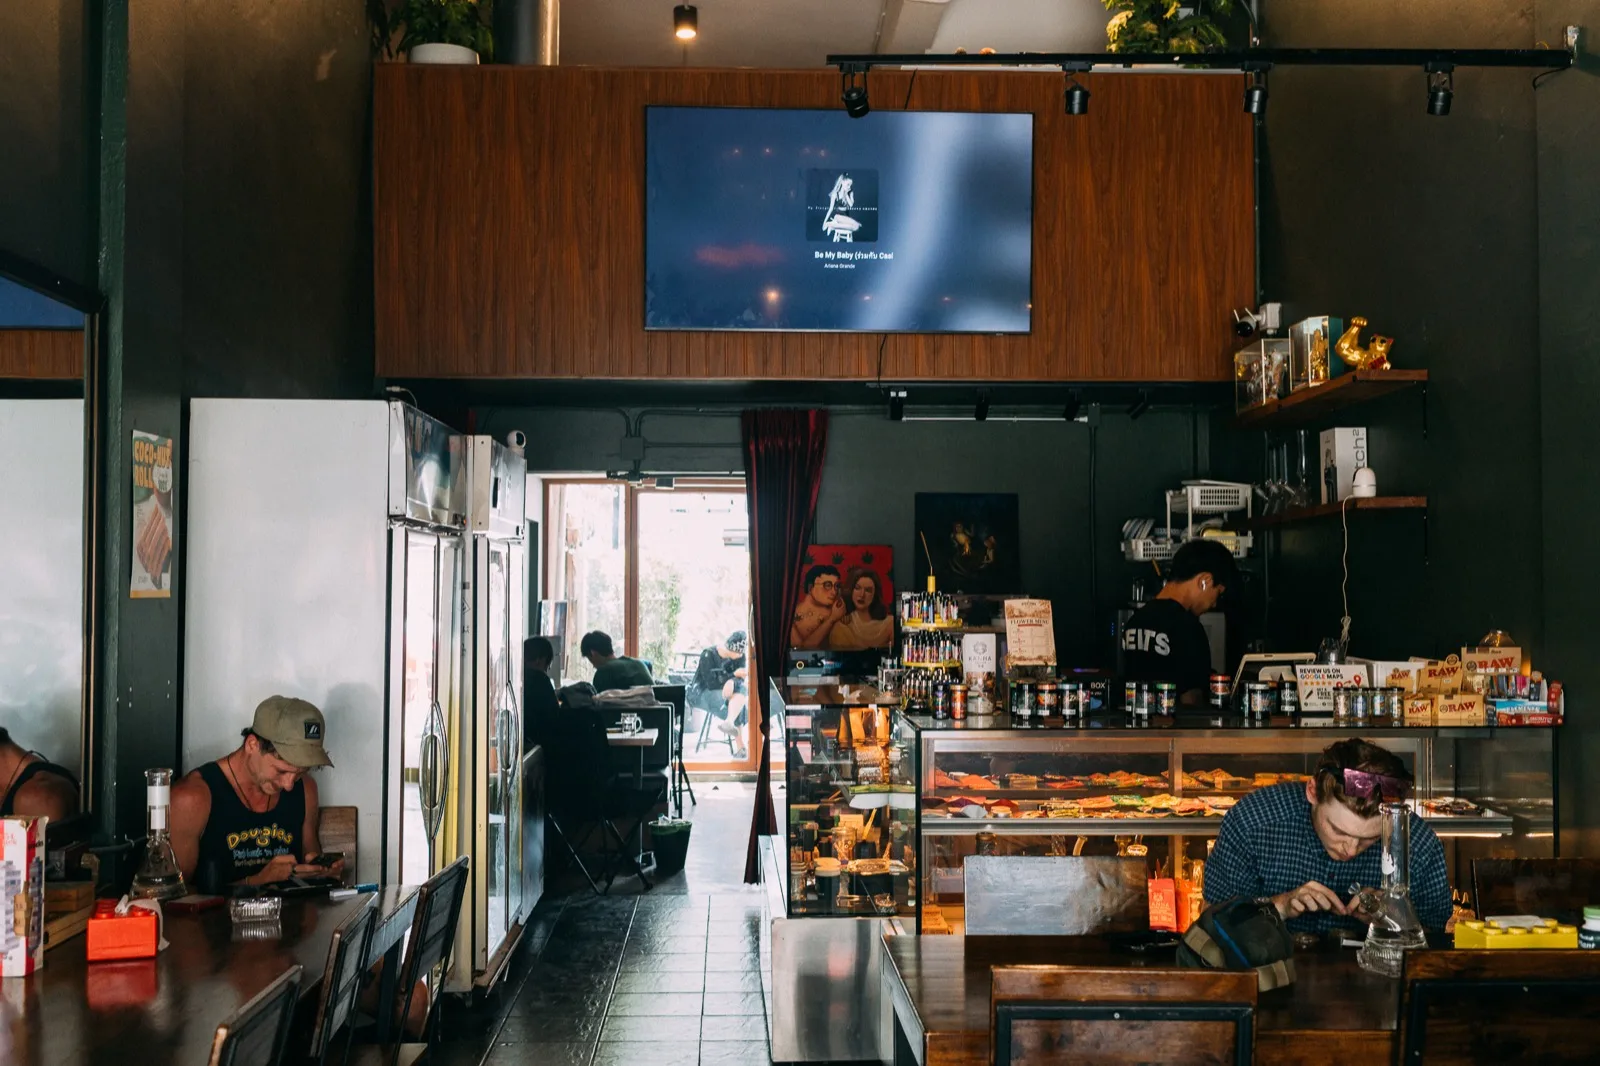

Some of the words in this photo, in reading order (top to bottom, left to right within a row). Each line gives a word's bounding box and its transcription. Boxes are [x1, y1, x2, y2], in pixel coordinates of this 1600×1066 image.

[814, 251, 824, 259] Be
[825, 251, 836, 260] My
[837, 251, 853, 260] Baby
[1477, 657, 1515, 668] RAW
[1391, 670, 1410, 680] RAW
[1428, 667, 1459, 678] RAW
[1408, 705, 1428, 715] RAW
[1448, 702, 1476, 713] RAW
[226, 823, 294, 850] Dougies
